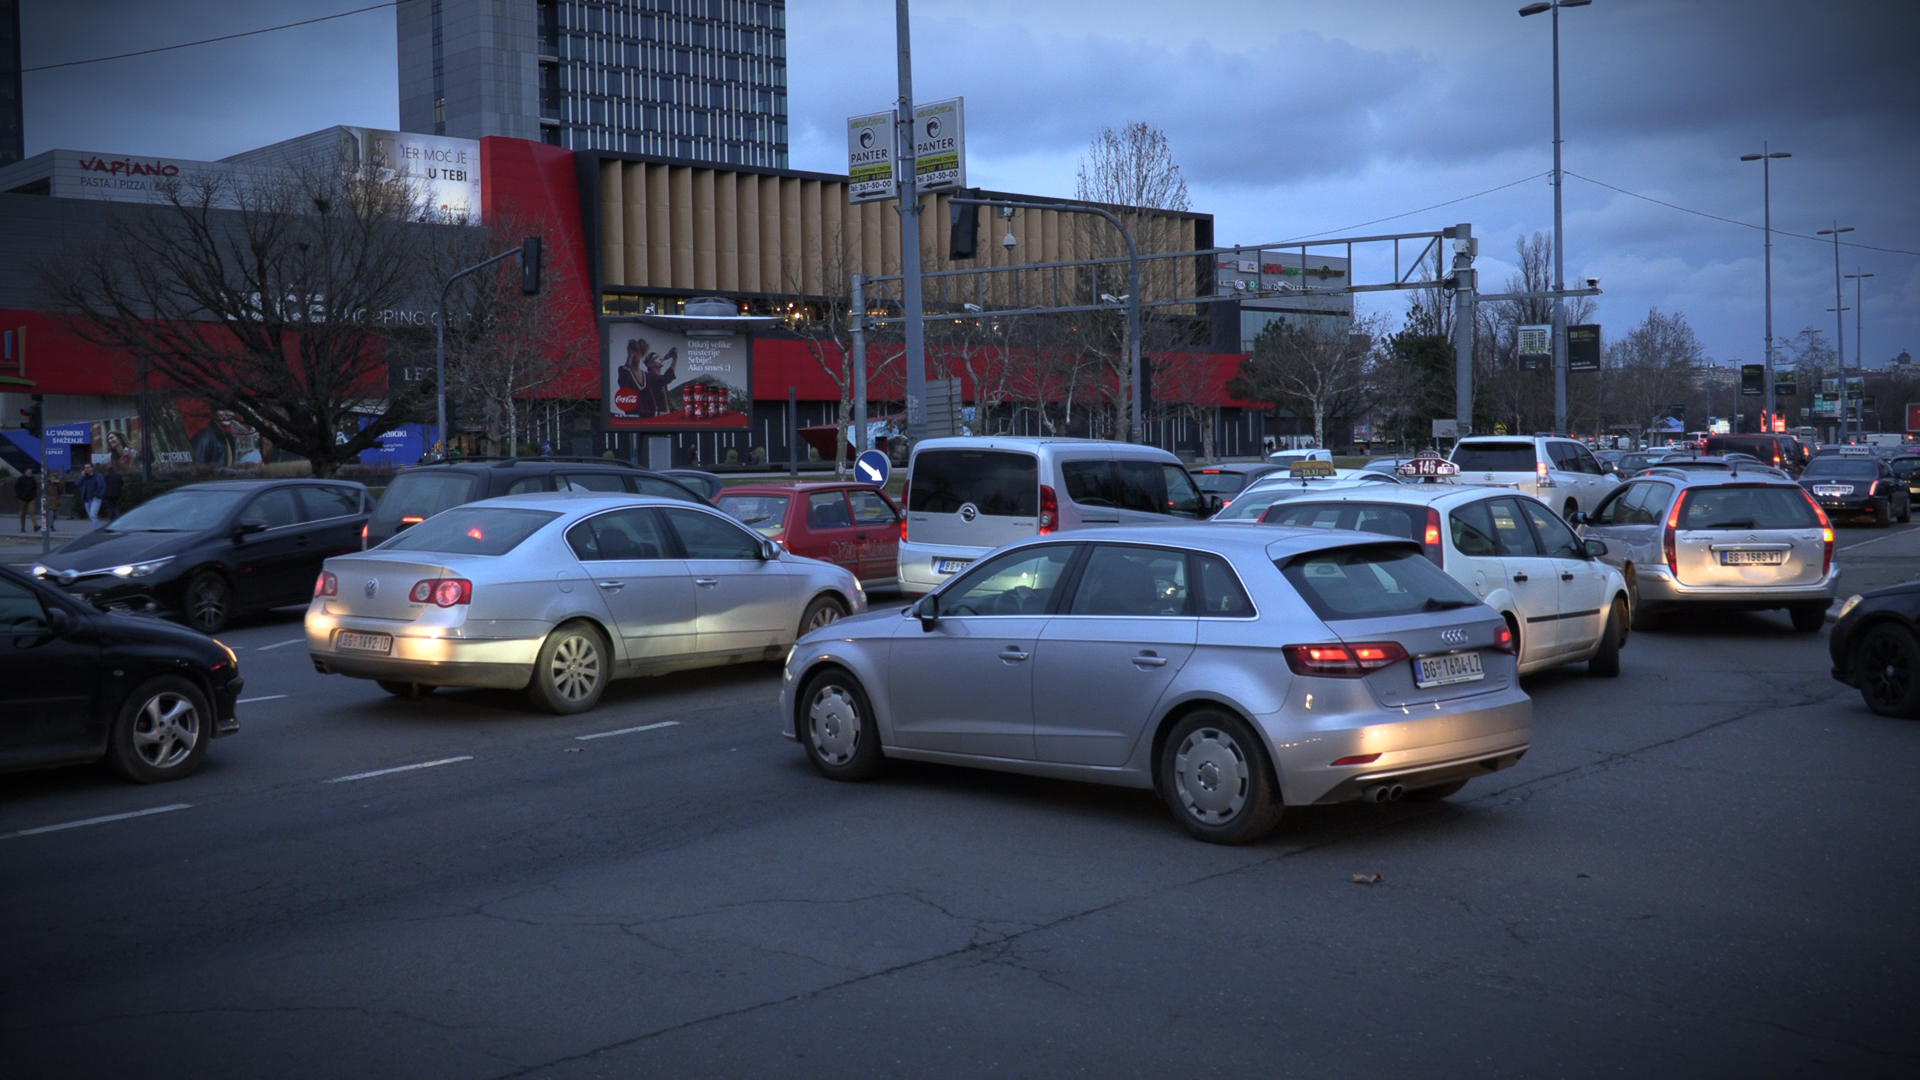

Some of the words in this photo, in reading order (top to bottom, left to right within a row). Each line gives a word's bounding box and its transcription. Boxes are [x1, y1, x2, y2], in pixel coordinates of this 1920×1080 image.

[917, 138, 954, 153] PANTER
[401, 147, 420, 159] JER
[424, 149, 452, 163] MOĆ
[456, 152, 467, 164] JE
[851, 149, 888, 163] PANTER
[428, 168, 437, 179] U
[441, 169, 467, 182] TEBI
[926, 170, 958, 182] 267-50-00
[80, 177, 110, 188] PASTA
[120, 180, 147, 191] PIZZA
[859, 180, 892, 191] 267-50-00
[688, 340, 709, 350] Otkrij
[710, 341, 732, 349] velike
[688, 349, 720, 358] misterije
[688, 356, 712, 366] Srbije!
[688, 364, 703, 372] Ako
[704, 363, 724, 371] smeš
[1418, 460, 1436, 474] 146
[1422, 660, 1437, 679] BG
